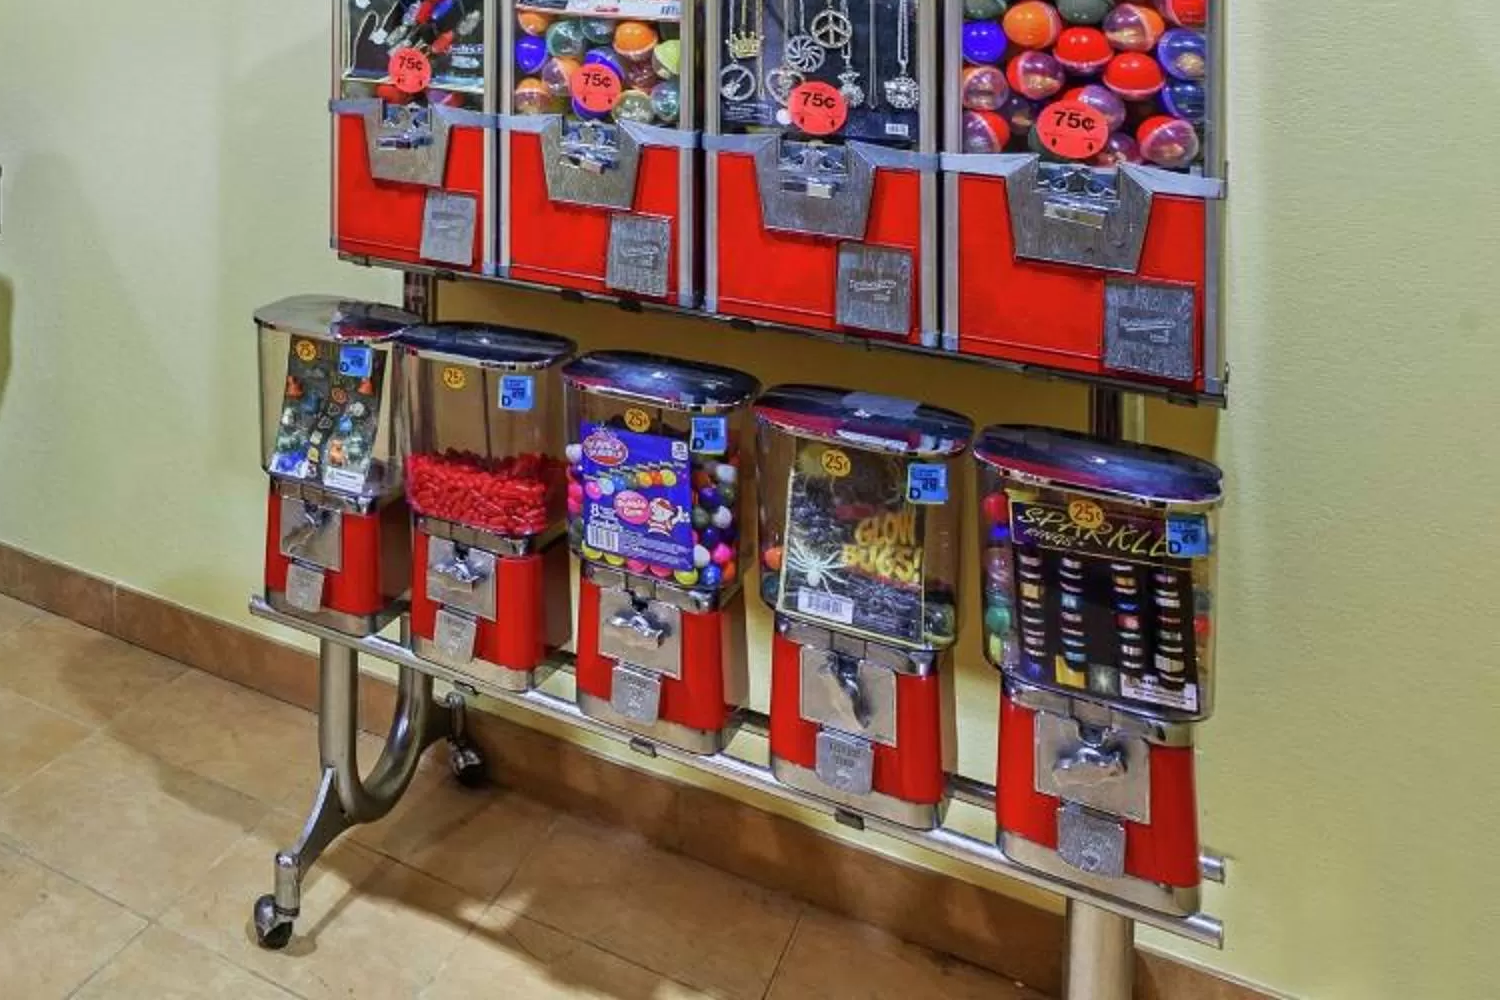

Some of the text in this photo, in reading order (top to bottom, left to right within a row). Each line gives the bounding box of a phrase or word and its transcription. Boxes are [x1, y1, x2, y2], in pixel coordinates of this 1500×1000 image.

[582, 73, 613, 88] 75¢
[1053, 111, 1095, 131] 75¢
[854, 511, 916, 546] GLOW
[844, 544, 923, 584] BUGS!
